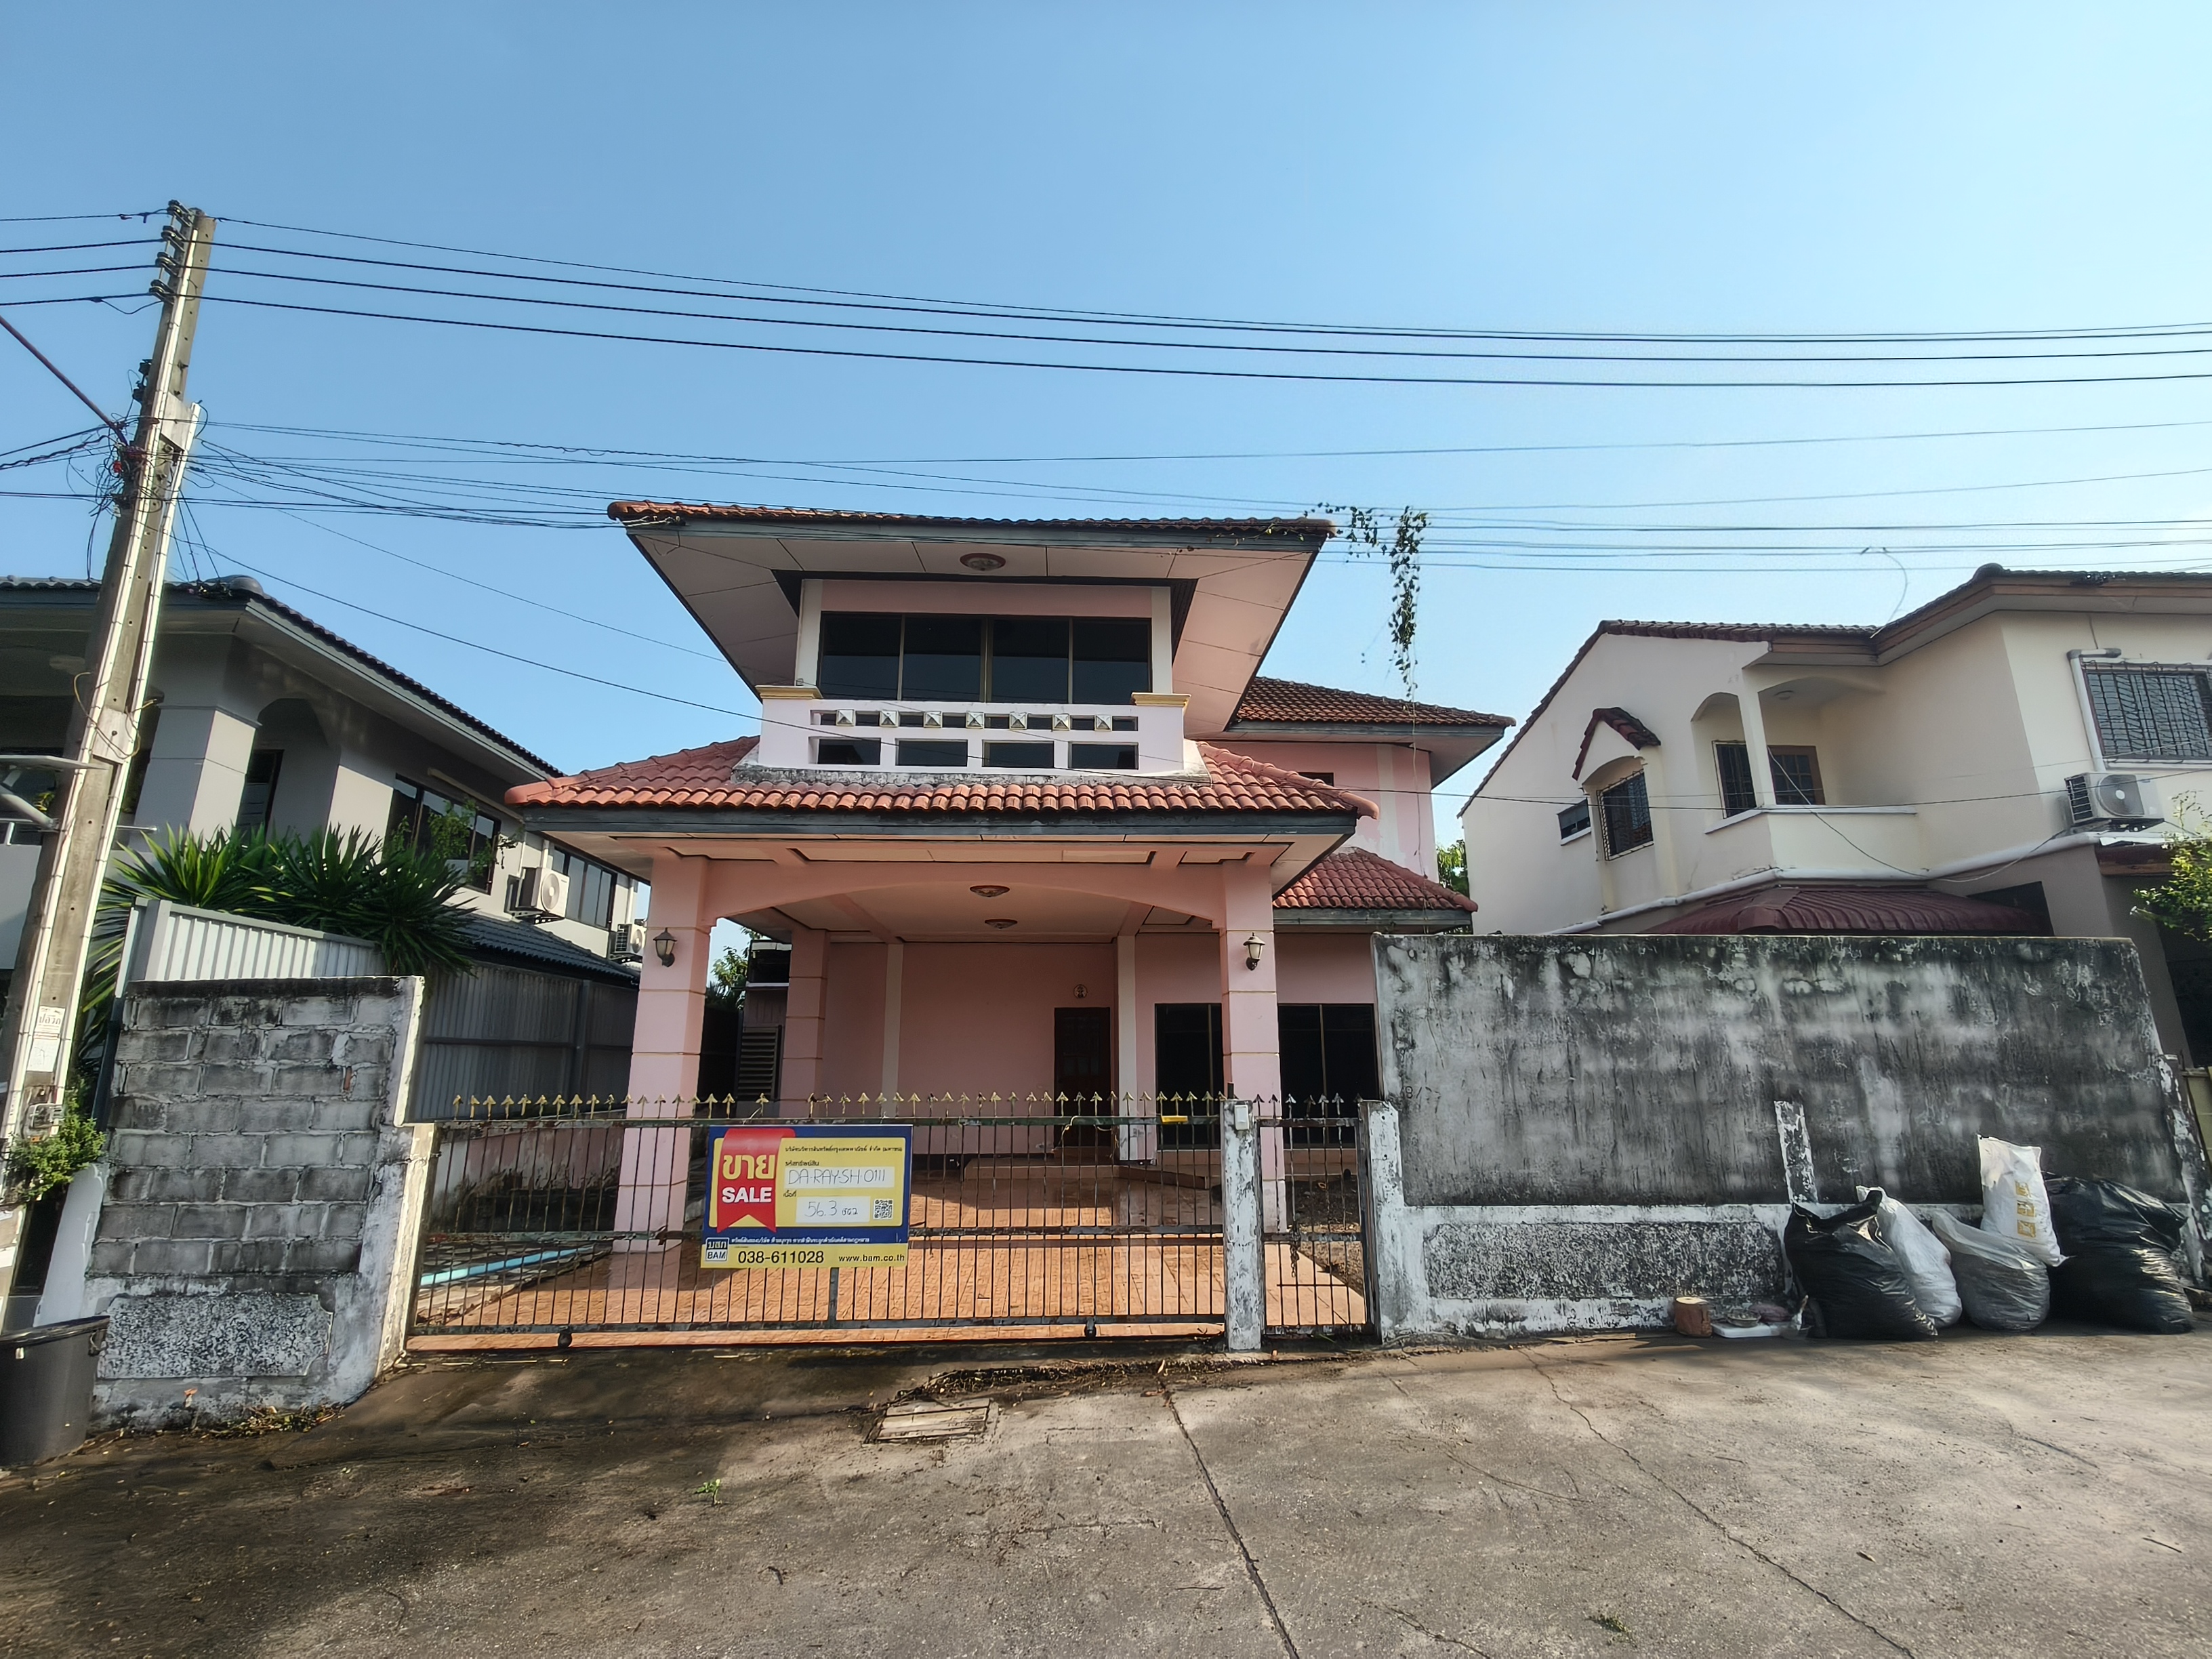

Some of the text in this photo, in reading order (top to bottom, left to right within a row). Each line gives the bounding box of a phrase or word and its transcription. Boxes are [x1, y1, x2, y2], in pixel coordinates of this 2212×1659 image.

[722, 1154, 776, 1180] ขาย
[722, 1187, 772, 1203] SALE
[804, 1200, 838, 1217] 56.3
[707, 1251, 726, 1260] BAM
[737, 1250, 905, 1264] 038-611028 www.bam.co.th
